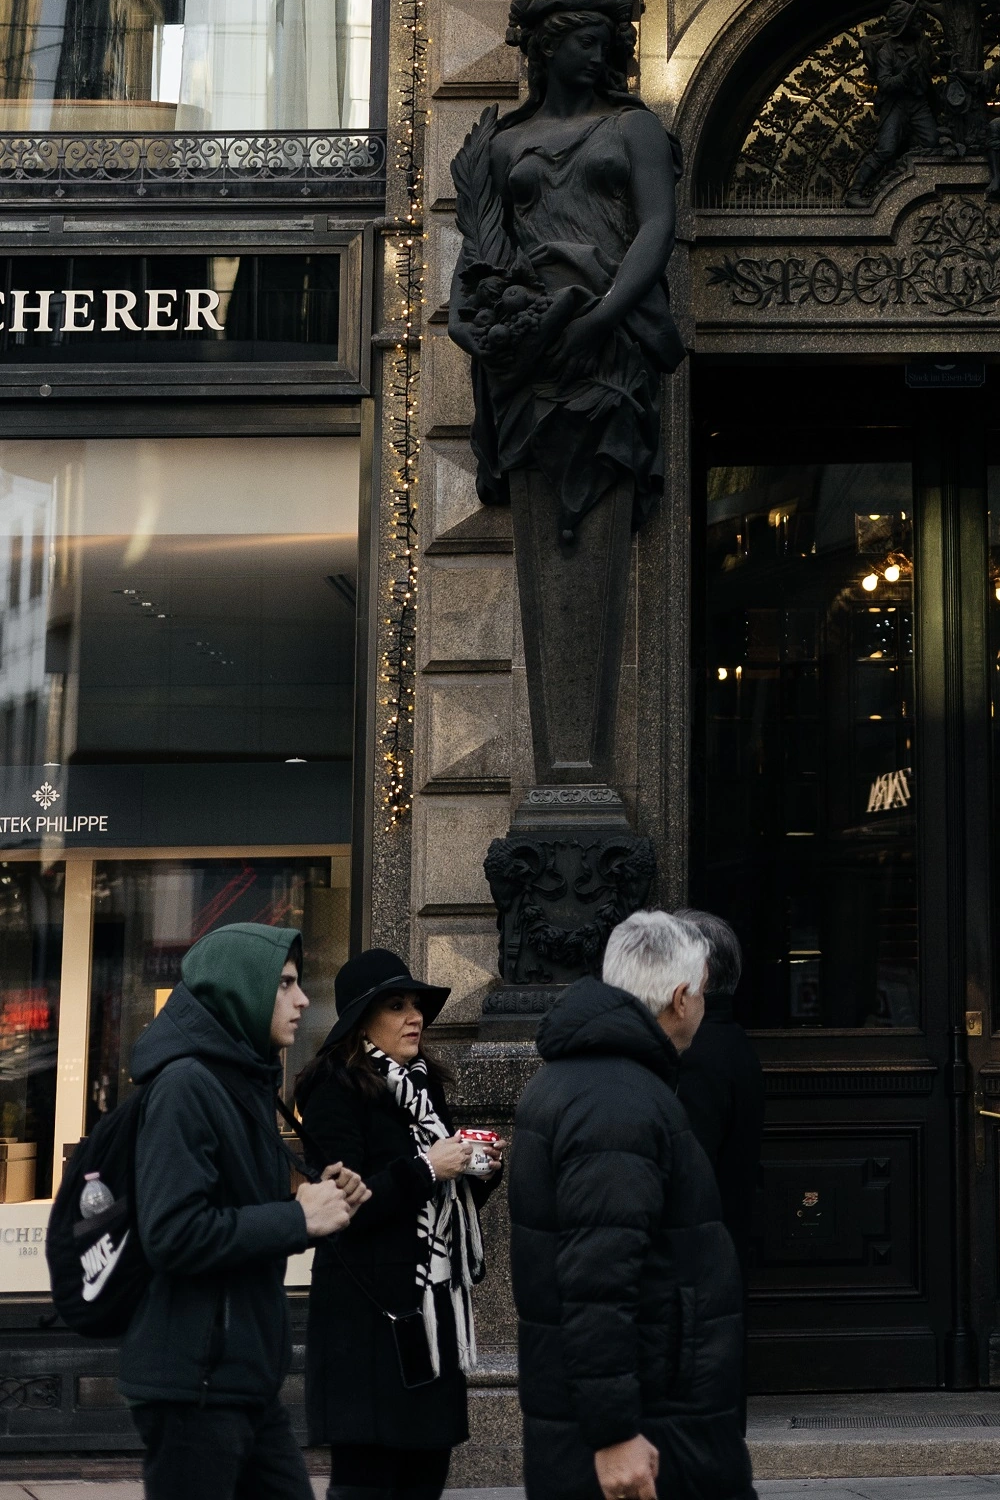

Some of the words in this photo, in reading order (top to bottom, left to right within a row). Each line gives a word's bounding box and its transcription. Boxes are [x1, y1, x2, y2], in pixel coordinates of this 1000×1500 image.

[732, 254, 928, 305] STOCK
[942, 264, 994, 296] IM
[0, 289, 225, 332] HERER
[0, 816, 31, 833] TEK
[36, 815, 108, 833] PHILIPPE
[0, 1227, 50, 1243] CHE
[80, 1232, 117, 1282] NIKE
